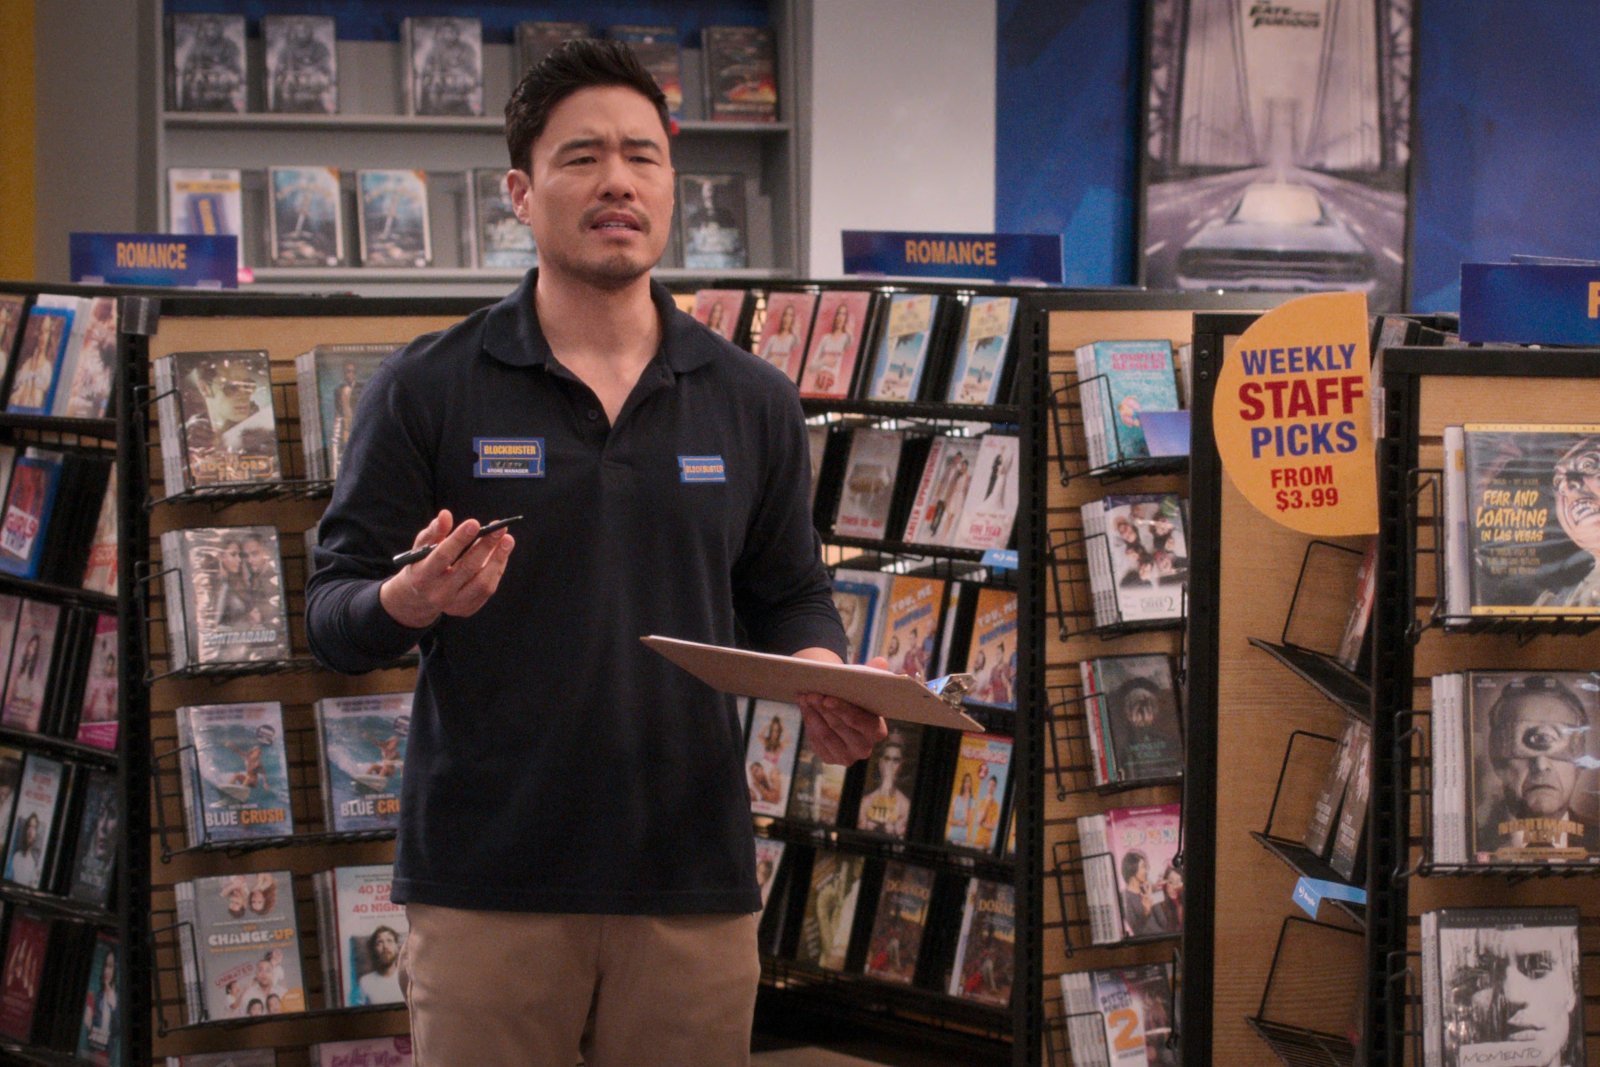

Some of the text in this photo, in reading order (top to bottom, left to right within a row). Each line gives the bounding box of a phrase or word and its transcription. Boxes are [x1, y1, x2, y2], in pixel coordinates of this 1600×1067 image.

[116, 242, 187, 269] ROMANCE
[905, 240, 997, 266] ROMANCE
[1241, 344, 1356, 375] WEEKLY
[1238, 376, 1364, 421] STAFF
[484, 445, 536, 455] BLOCKBUSTER
[1251, 421, 1358, 458] PICKS
[684, 465, 724, 473] BLOCKBUSTER
[1270, 465, 1334, 488] FROM
[1275, 488, 1339, 512] $3.99
[1483, 489, 1539, 507] FEAR AND
[1475, 505, 1548, 529] LOATHING
[1481, 529, 1544, 542] IN LAS VEGAS
[204, 630, 277, 648] CONTRABAND
[205, 808, 285, 827] BLUE CRUSH
[341, 800, 375, 817] BLUE
[358, 883, 393, 895] 40 DA
[352, 902, 404, 913] 40 NIGH
[208, 928, 295, 946] CHANGE-UP
[215, 962, 256, 987] UNRATED
[1108, 1008, 1147, 1052] 2
